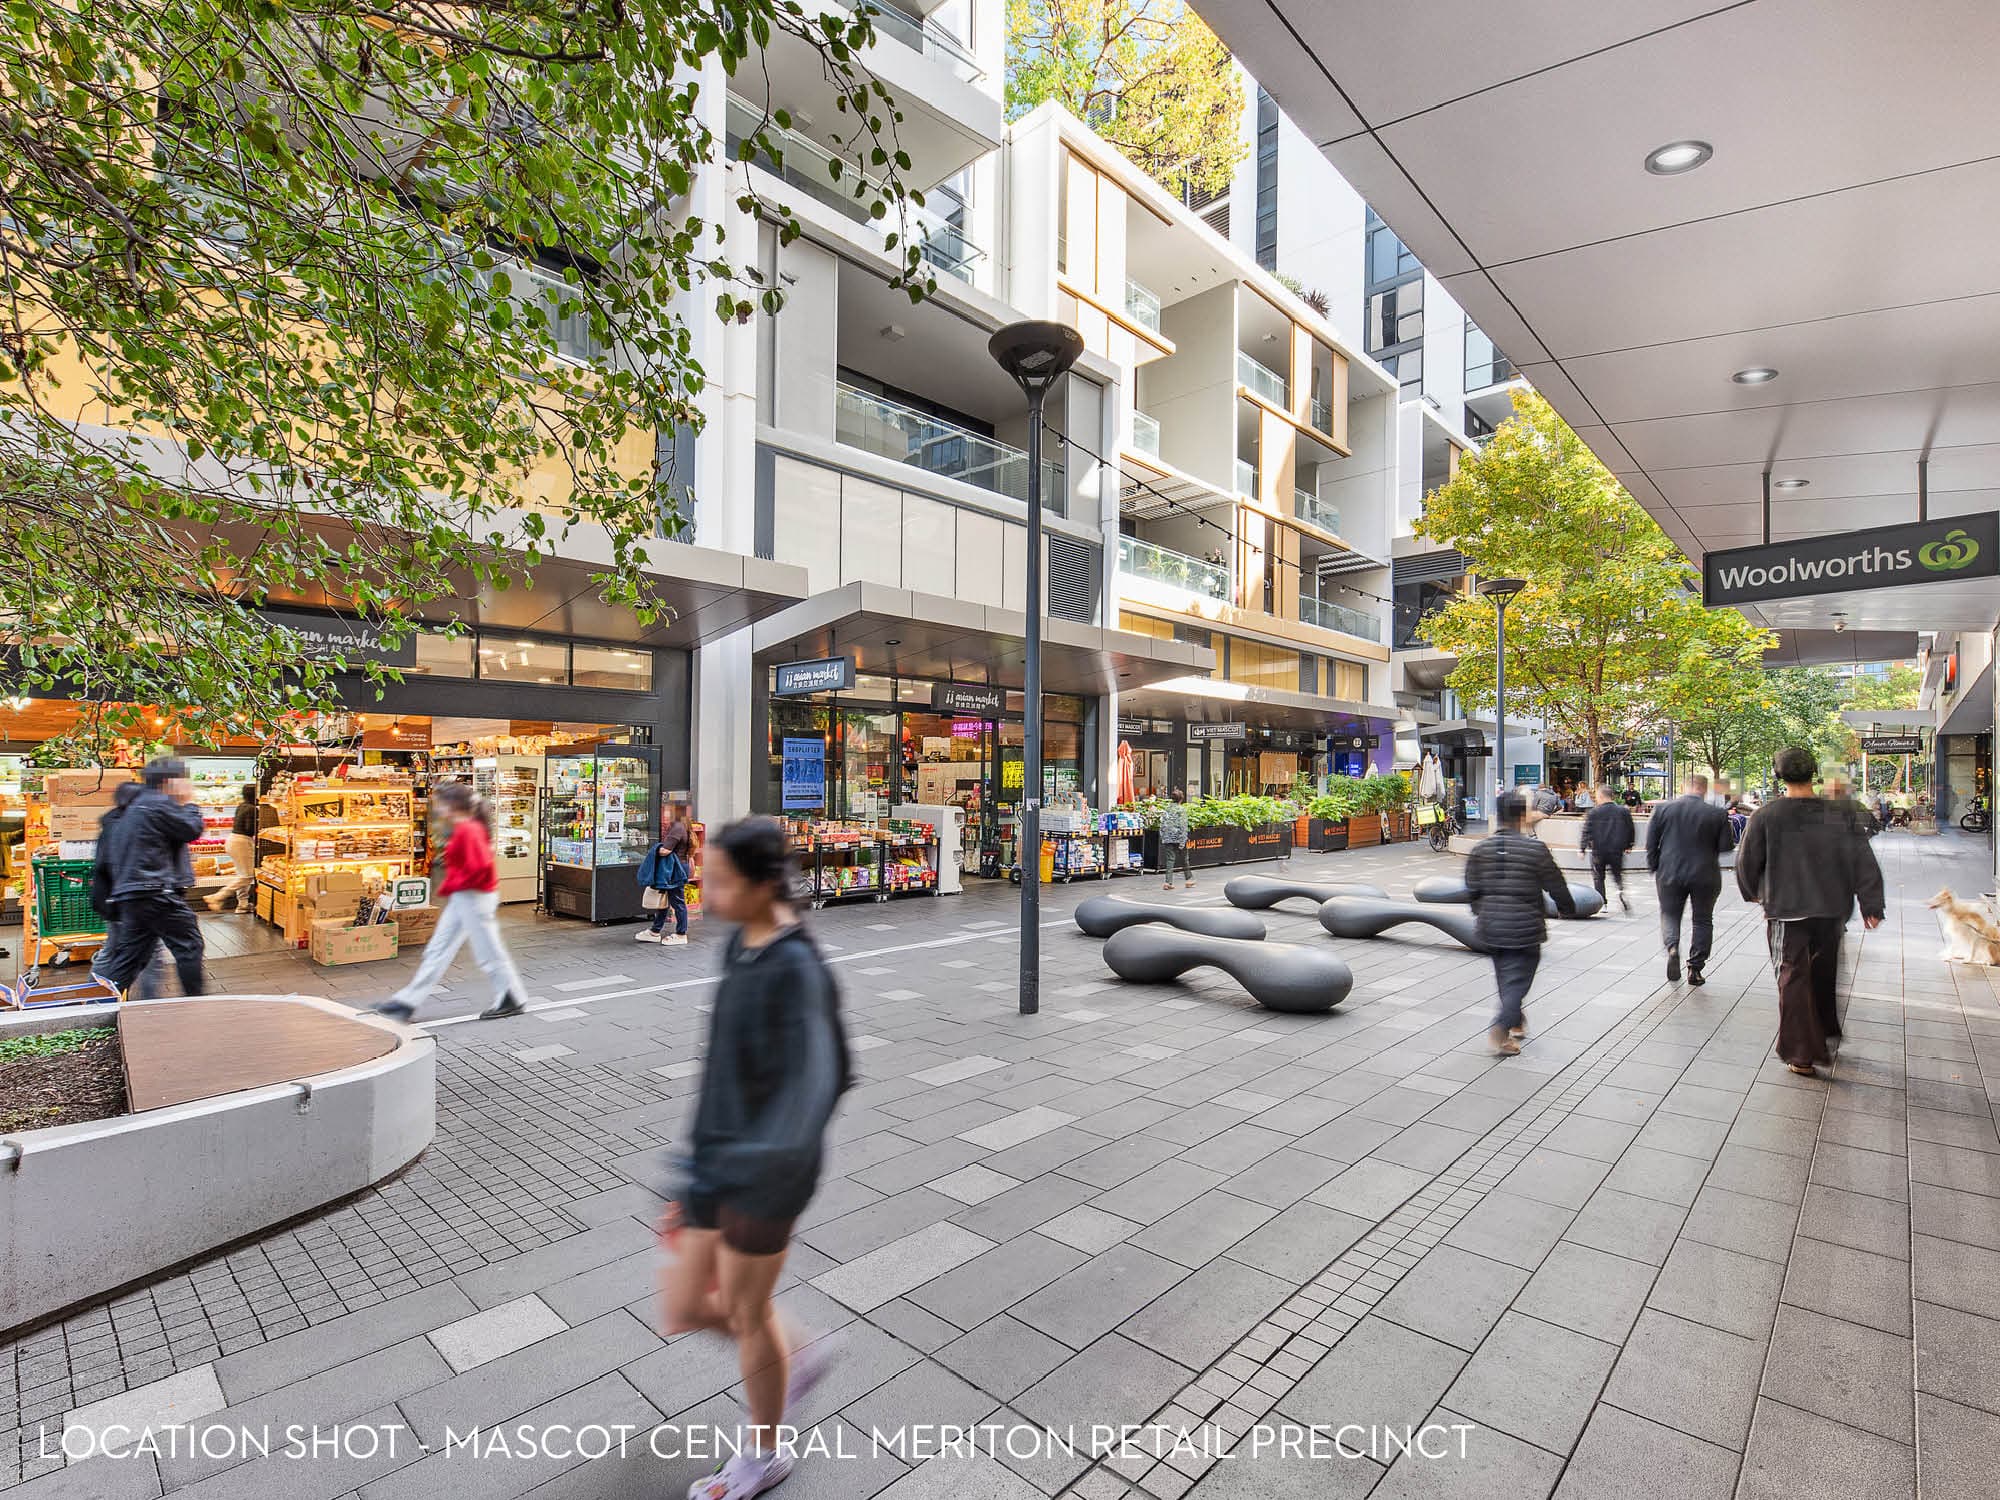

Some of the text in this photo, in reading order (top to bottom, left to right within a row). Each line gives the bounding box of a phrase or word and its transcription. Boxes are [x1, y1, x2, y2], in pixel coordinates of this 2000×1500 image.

[1719, 547, 1913, 590] Woolworths
[327, 629, 390, 652] marke
[785, 663, 839, 687] jj asian market
[945, 690, 1000, 708] jj asian market
